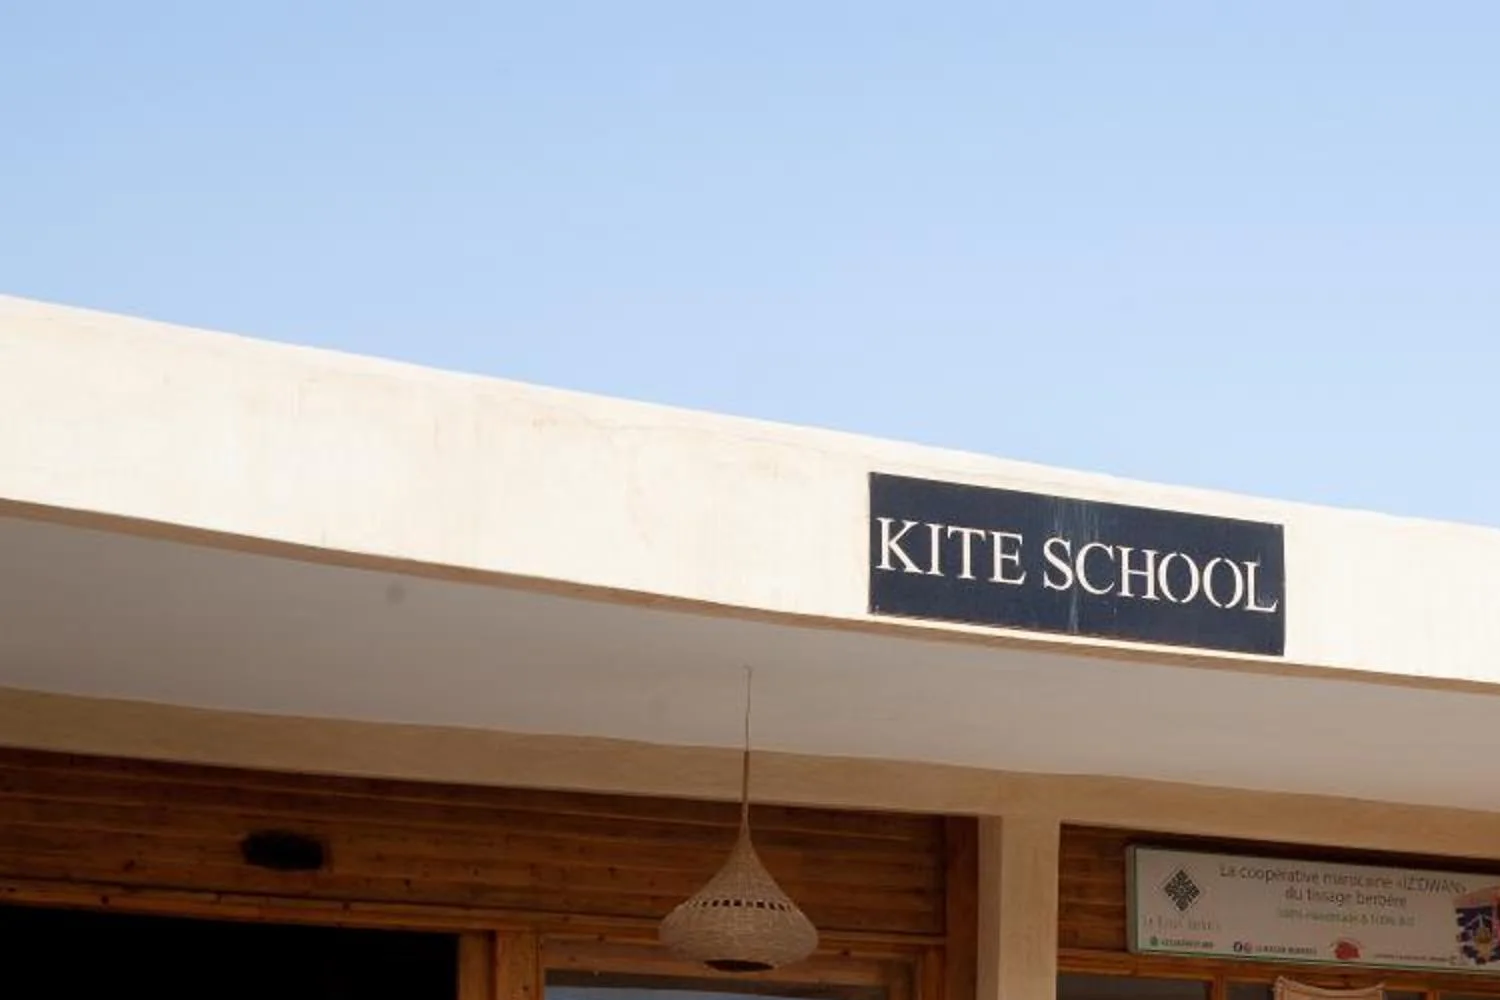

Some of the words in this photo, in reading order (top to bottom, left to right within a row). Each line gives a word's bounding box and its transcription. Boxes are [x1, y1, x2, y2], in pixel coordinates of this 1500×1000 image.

[875, 516, 1027, 587] KITE
[1042, 536, 1278, 614] SCHOOL
[1285, 886, 1303, 901] du
[1306, 888, 1353, 906] tissage
